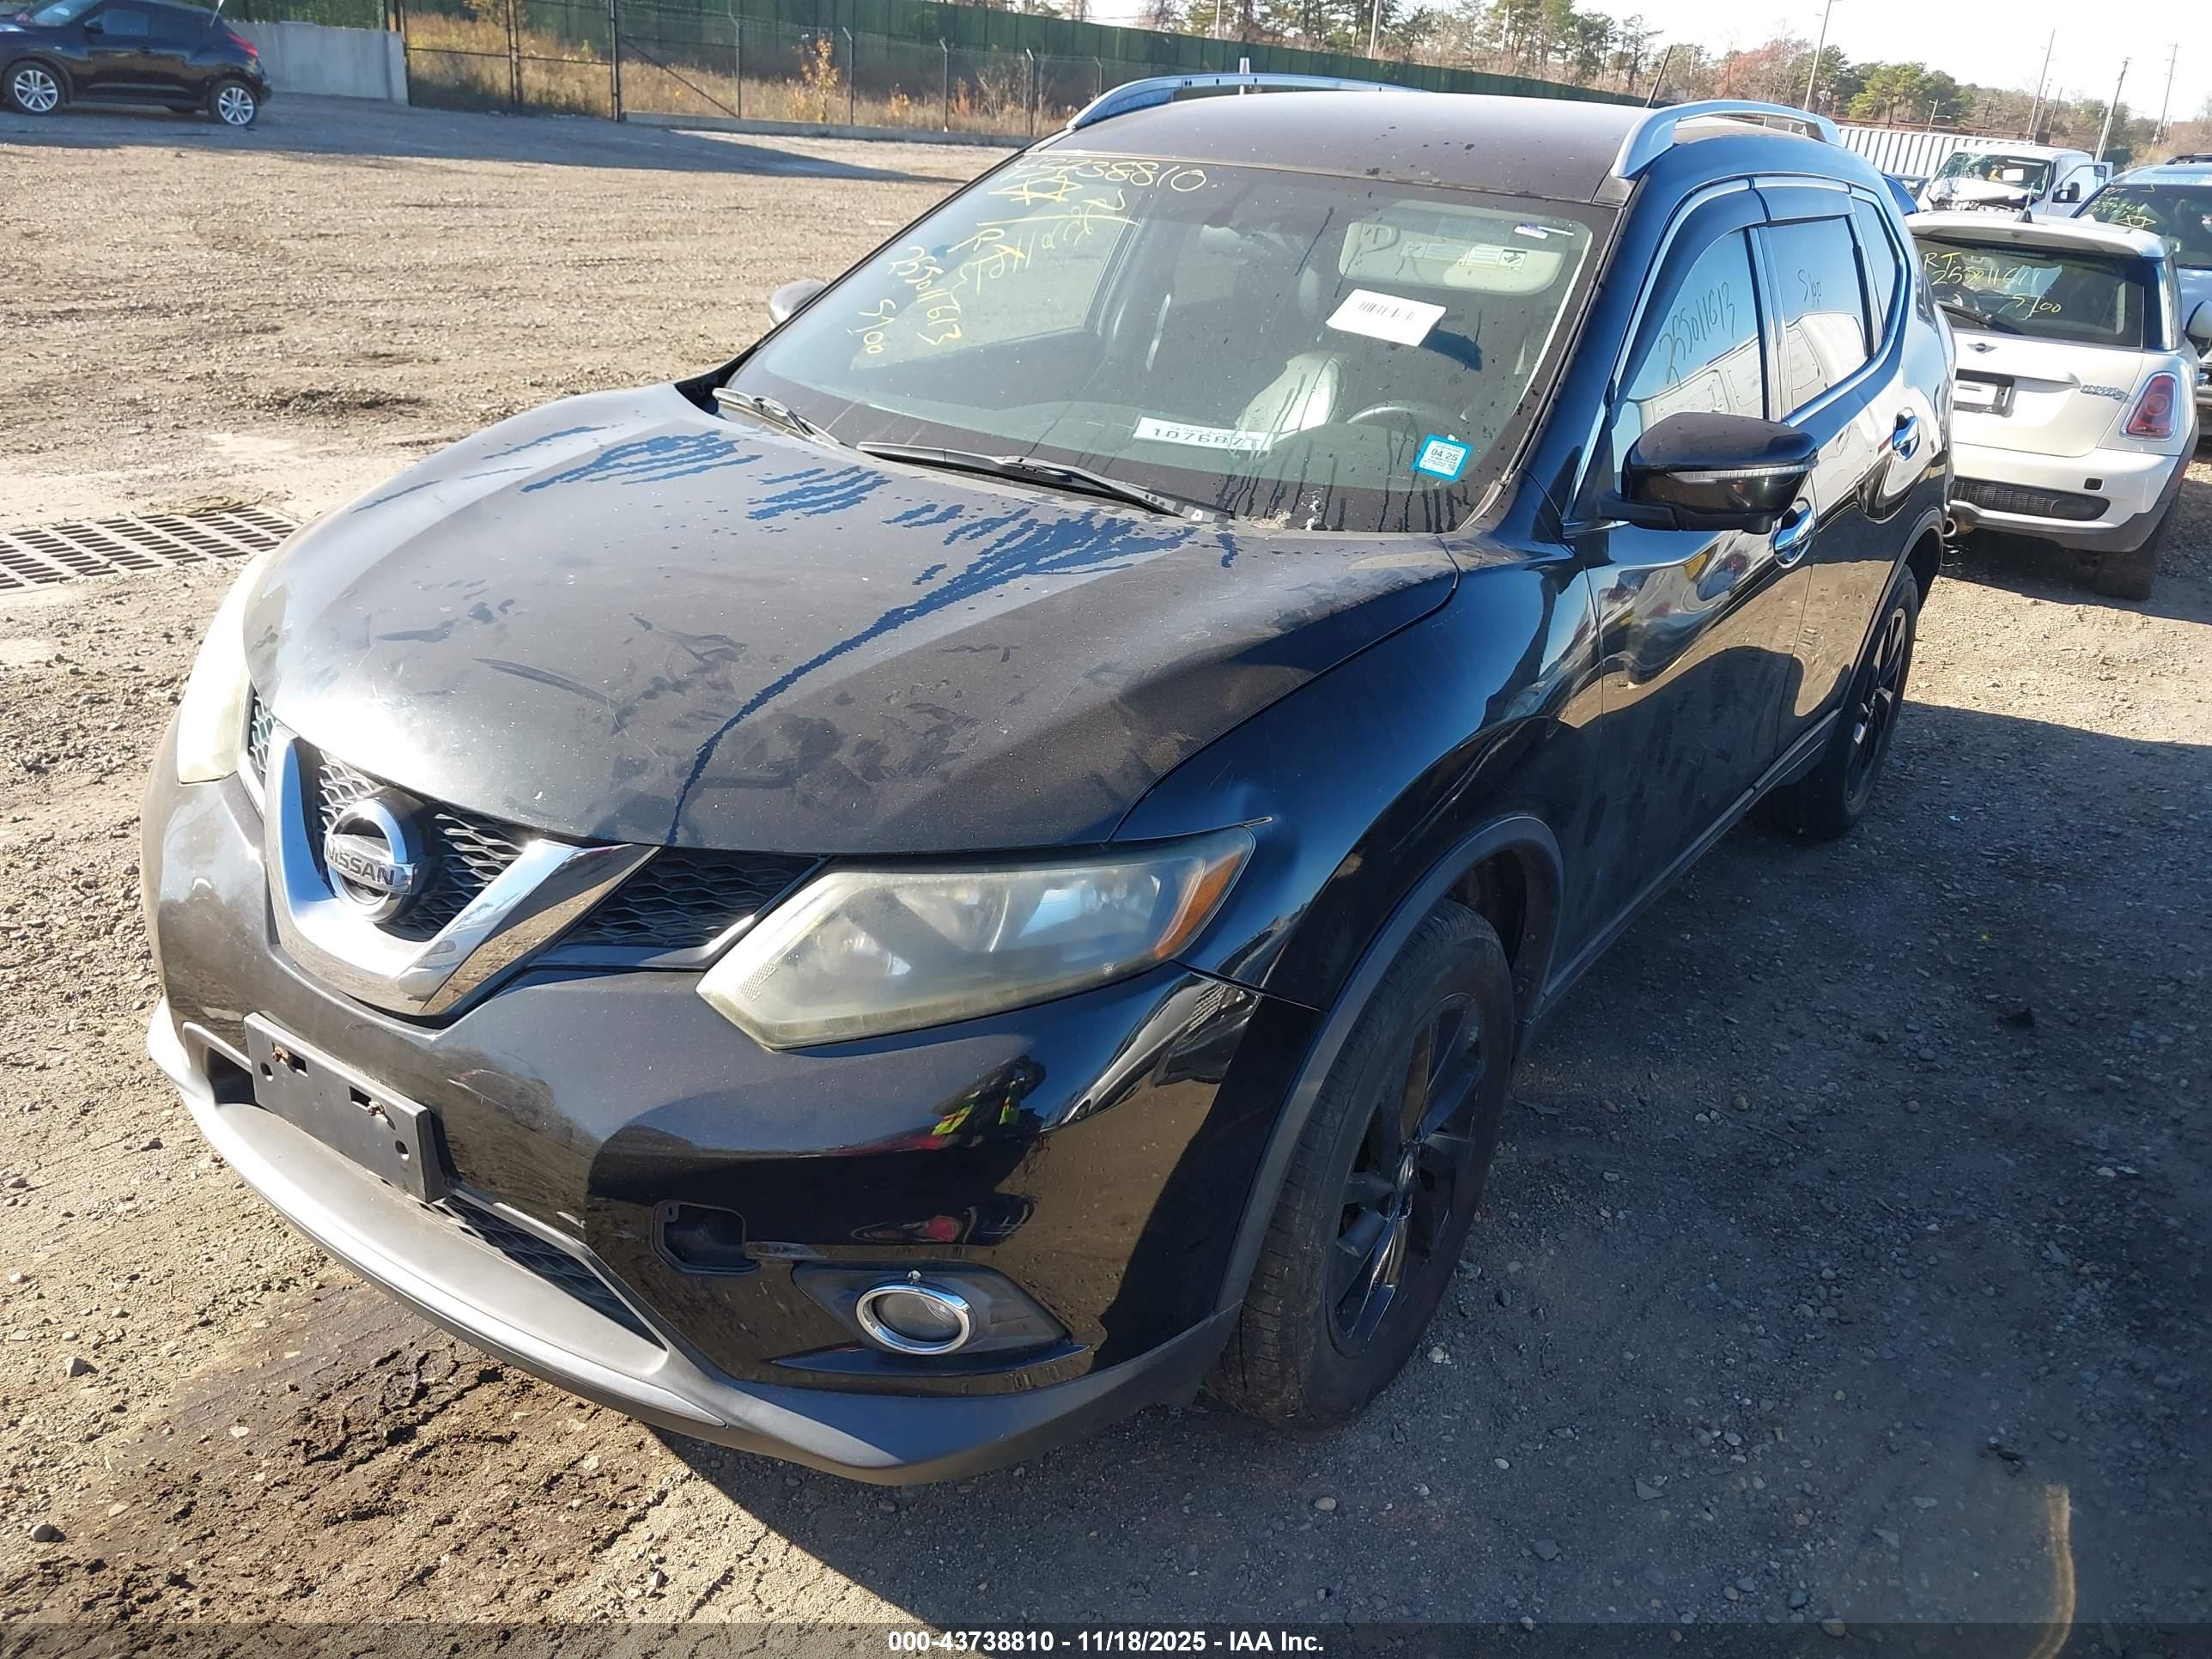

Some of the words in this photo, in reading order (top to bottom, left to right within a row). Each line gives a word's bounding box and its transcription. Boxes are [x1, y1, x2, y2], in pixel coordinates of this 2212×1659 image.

[1431, 447, 1443, 458] 04
[1445, 452, 1459, 462] 25
[326, 843, 395, 886] NISSAN
